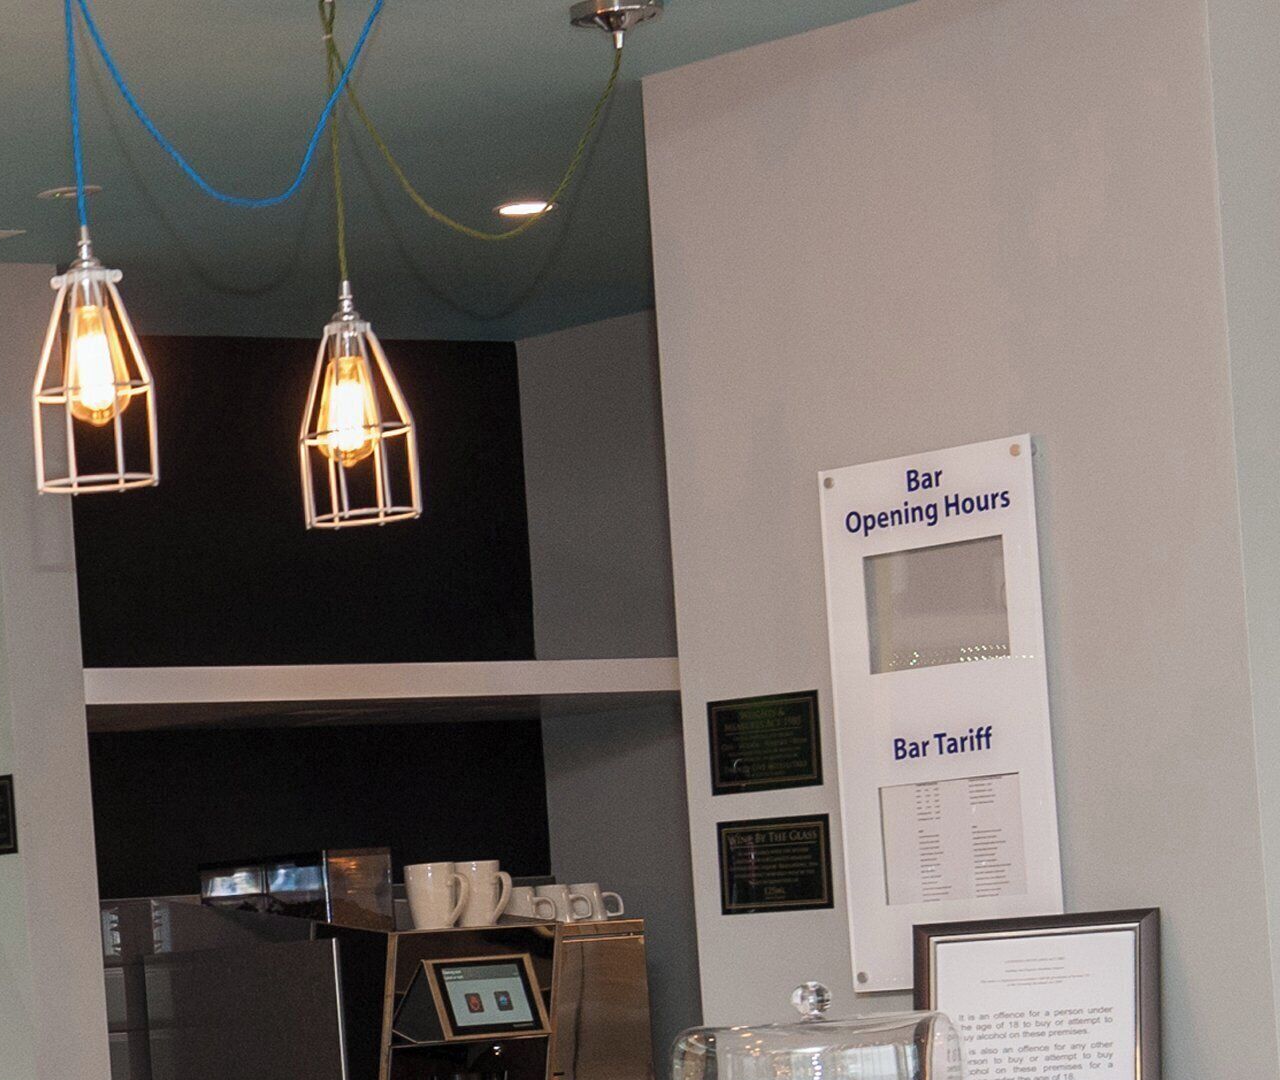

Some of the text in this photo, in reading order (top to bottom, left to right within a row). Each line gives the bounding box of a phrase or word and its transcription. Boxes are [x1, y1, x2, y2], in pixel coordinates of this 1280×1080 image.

[906, 469, 943, 492] Bar
[845, 490, 1011, 537] Opening Hours
[893, 725, 992, 760] Bar Tariff
